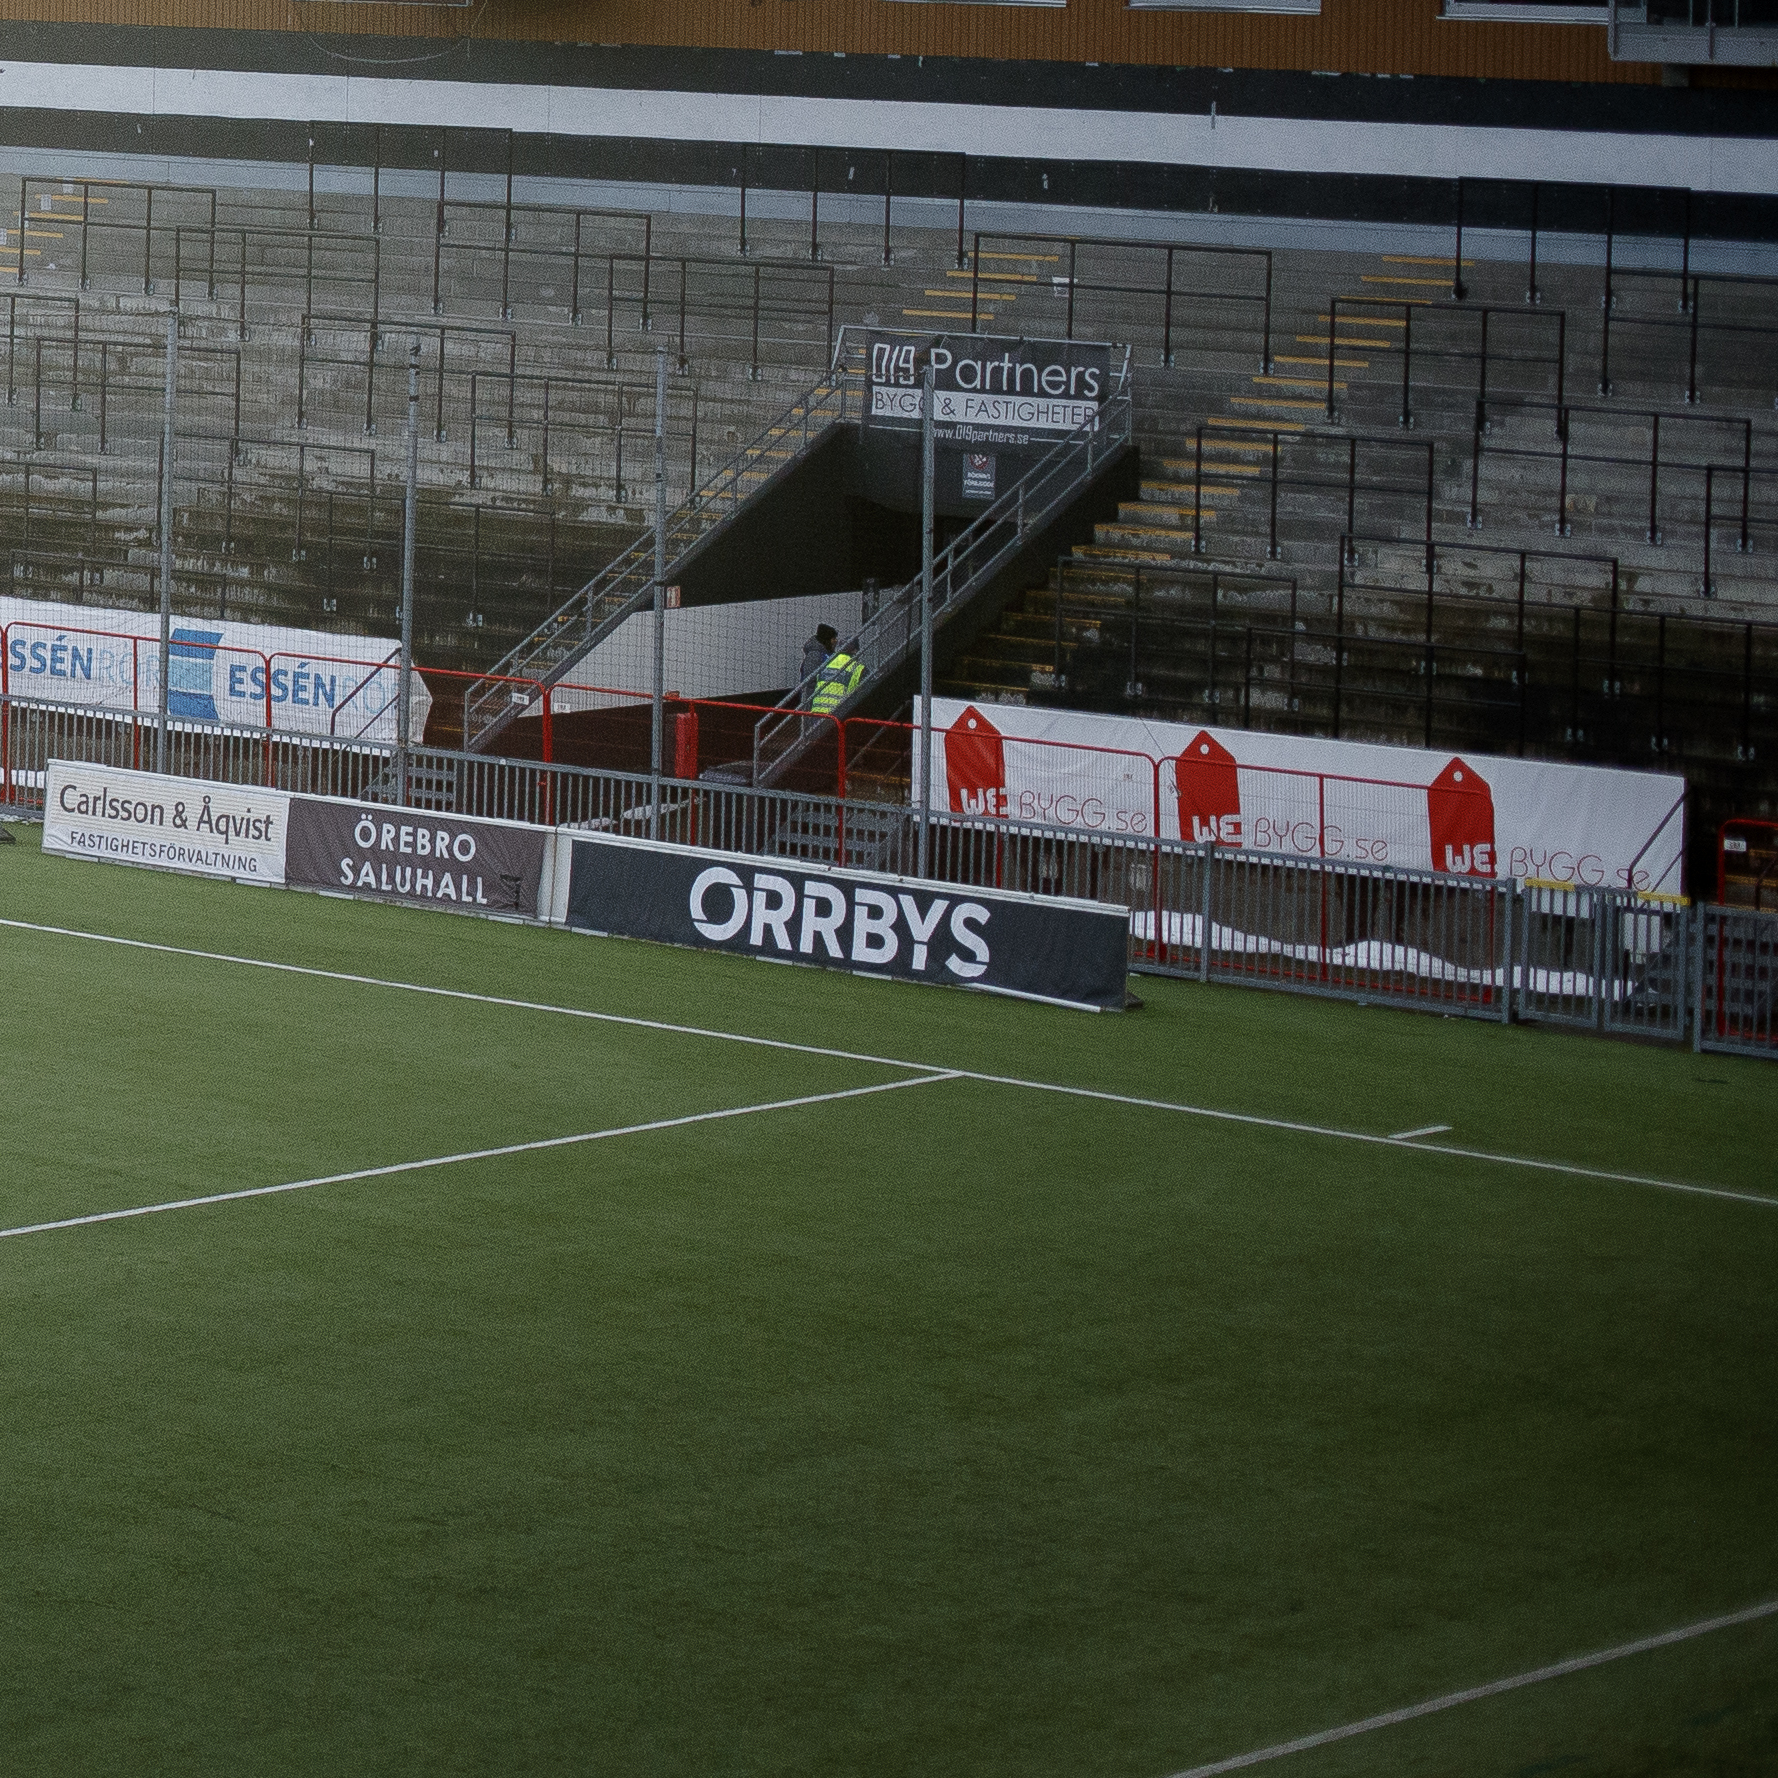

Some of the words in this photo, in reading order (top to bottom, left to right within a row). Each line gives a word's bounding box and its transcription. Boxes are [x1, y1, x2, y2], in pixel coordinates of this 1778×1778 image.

[930, 348, 1100, 398] Partners
[942, 398, 957, 417] &
[228, 661, 336, 709] ESSÉN
[59, 784, 165, 828] Carlsson
[172, 801, 189, 830] &
[196, 795, 273, 845] Åqvist
[960, 787, 1009, 819] WE
[1019, 789, 1148, 834] BYGG.se
[70, 830, 258, 873] FASTIGHETSFÖRVALTNING
[354, 813, 476, 862] ÖREBRO
[1192, 813, 1242, 844] WE
[1253, 817, 1389, 862] BYGG.se
[1444, 842, 1497, 873] WE
[340, 856, 488, 905] SALUHALL
[690, 866, 991, 978] ORRBYS
